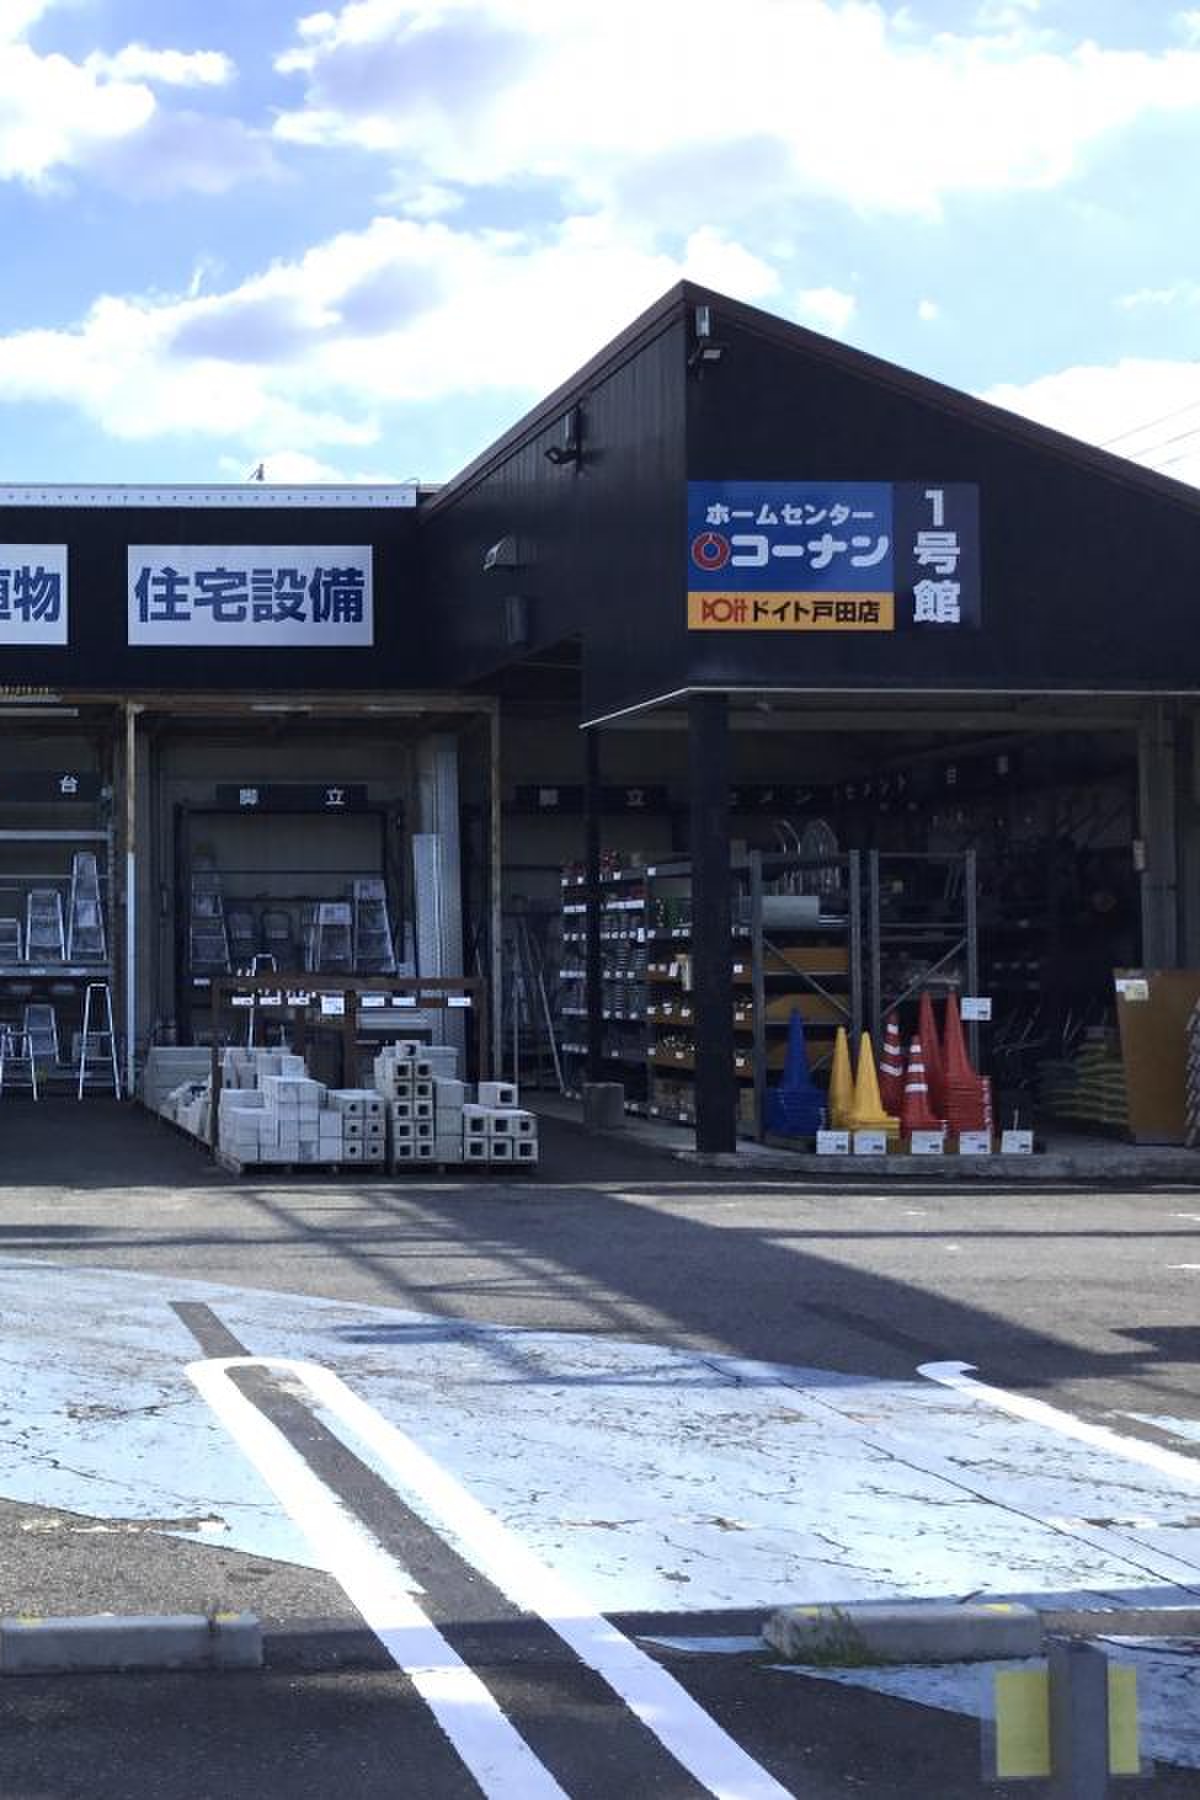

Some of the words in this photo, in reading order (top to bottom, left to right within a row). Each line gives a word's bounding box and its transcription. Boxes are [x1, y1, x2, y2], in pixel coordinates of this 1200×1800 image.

[706, 503, 874, 525] ホームセンター
[731, 533, 890, 569] コーナン
[913, 489, 960, 623] 1号館
[134, 567, 365, 623] 住宅設備
[753, 600, 881, 623] ドイト戸田店
